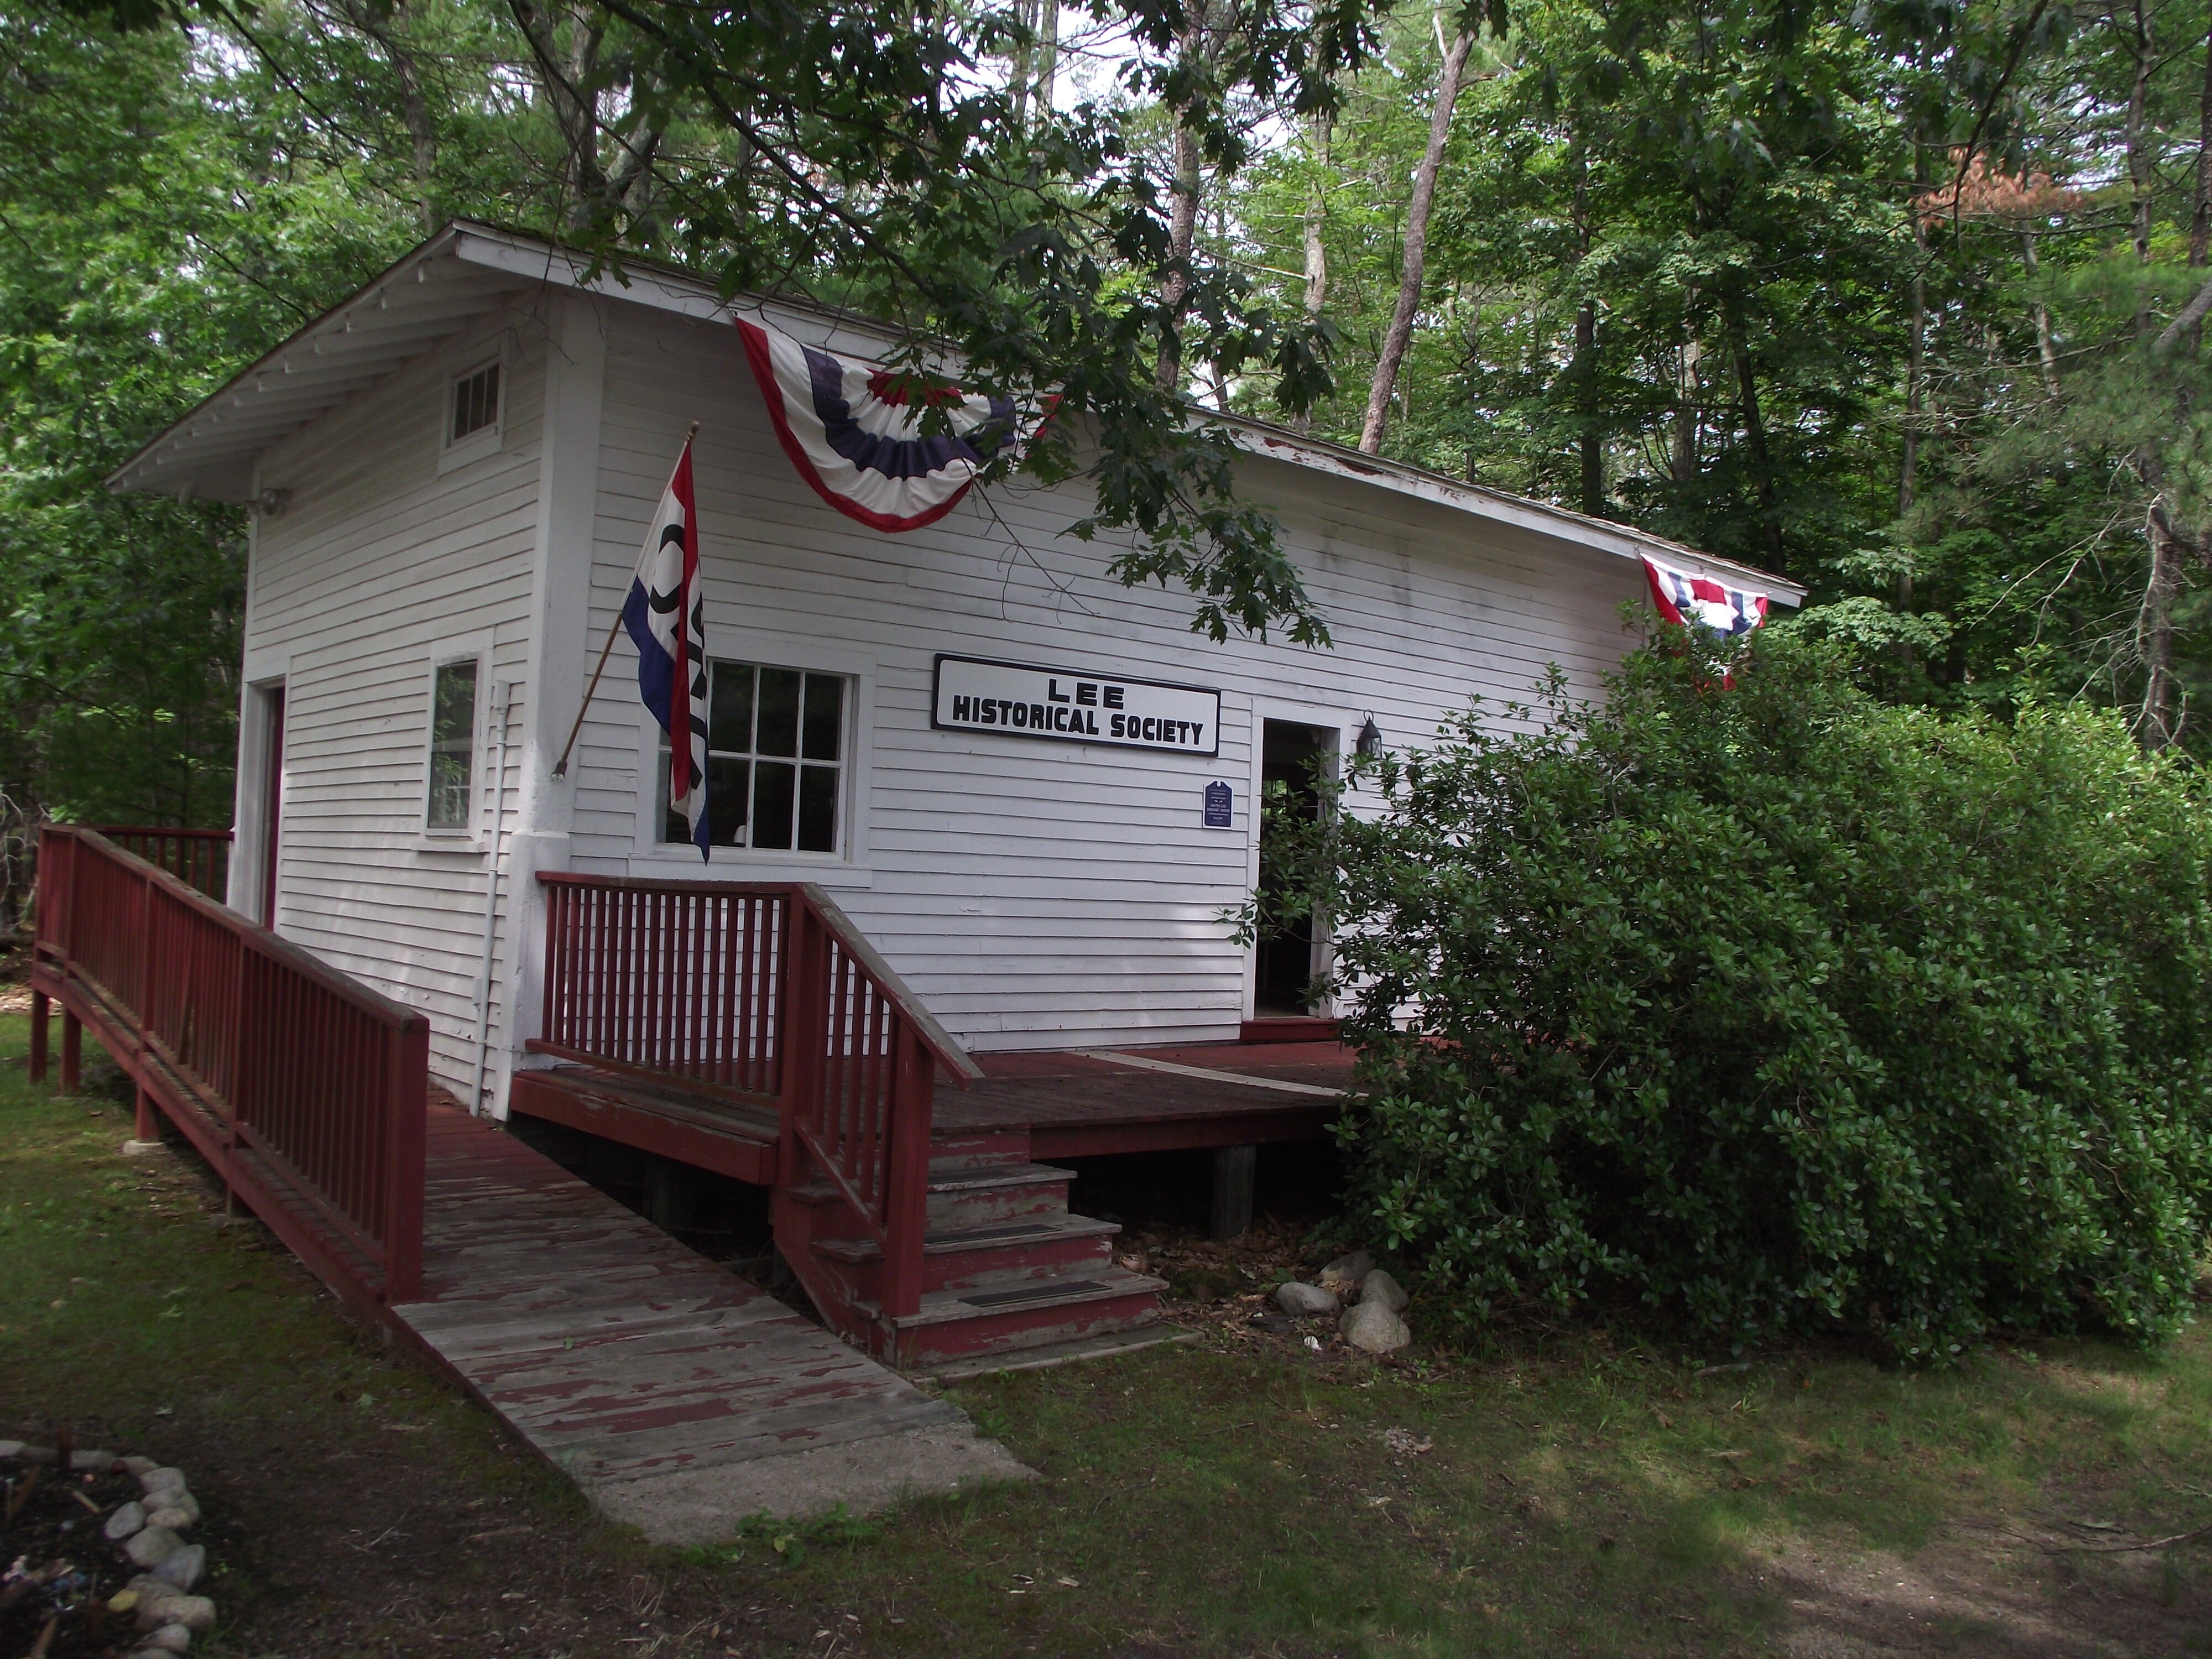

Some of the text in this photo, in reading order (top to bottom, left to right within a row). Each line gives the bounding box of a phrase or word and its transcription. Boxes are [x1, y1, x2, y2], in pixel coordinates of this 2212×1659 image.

[1048, 679, 1124, 709] LEE
[953, 695, 1203, 745] HISTORICAL SOCIETY
